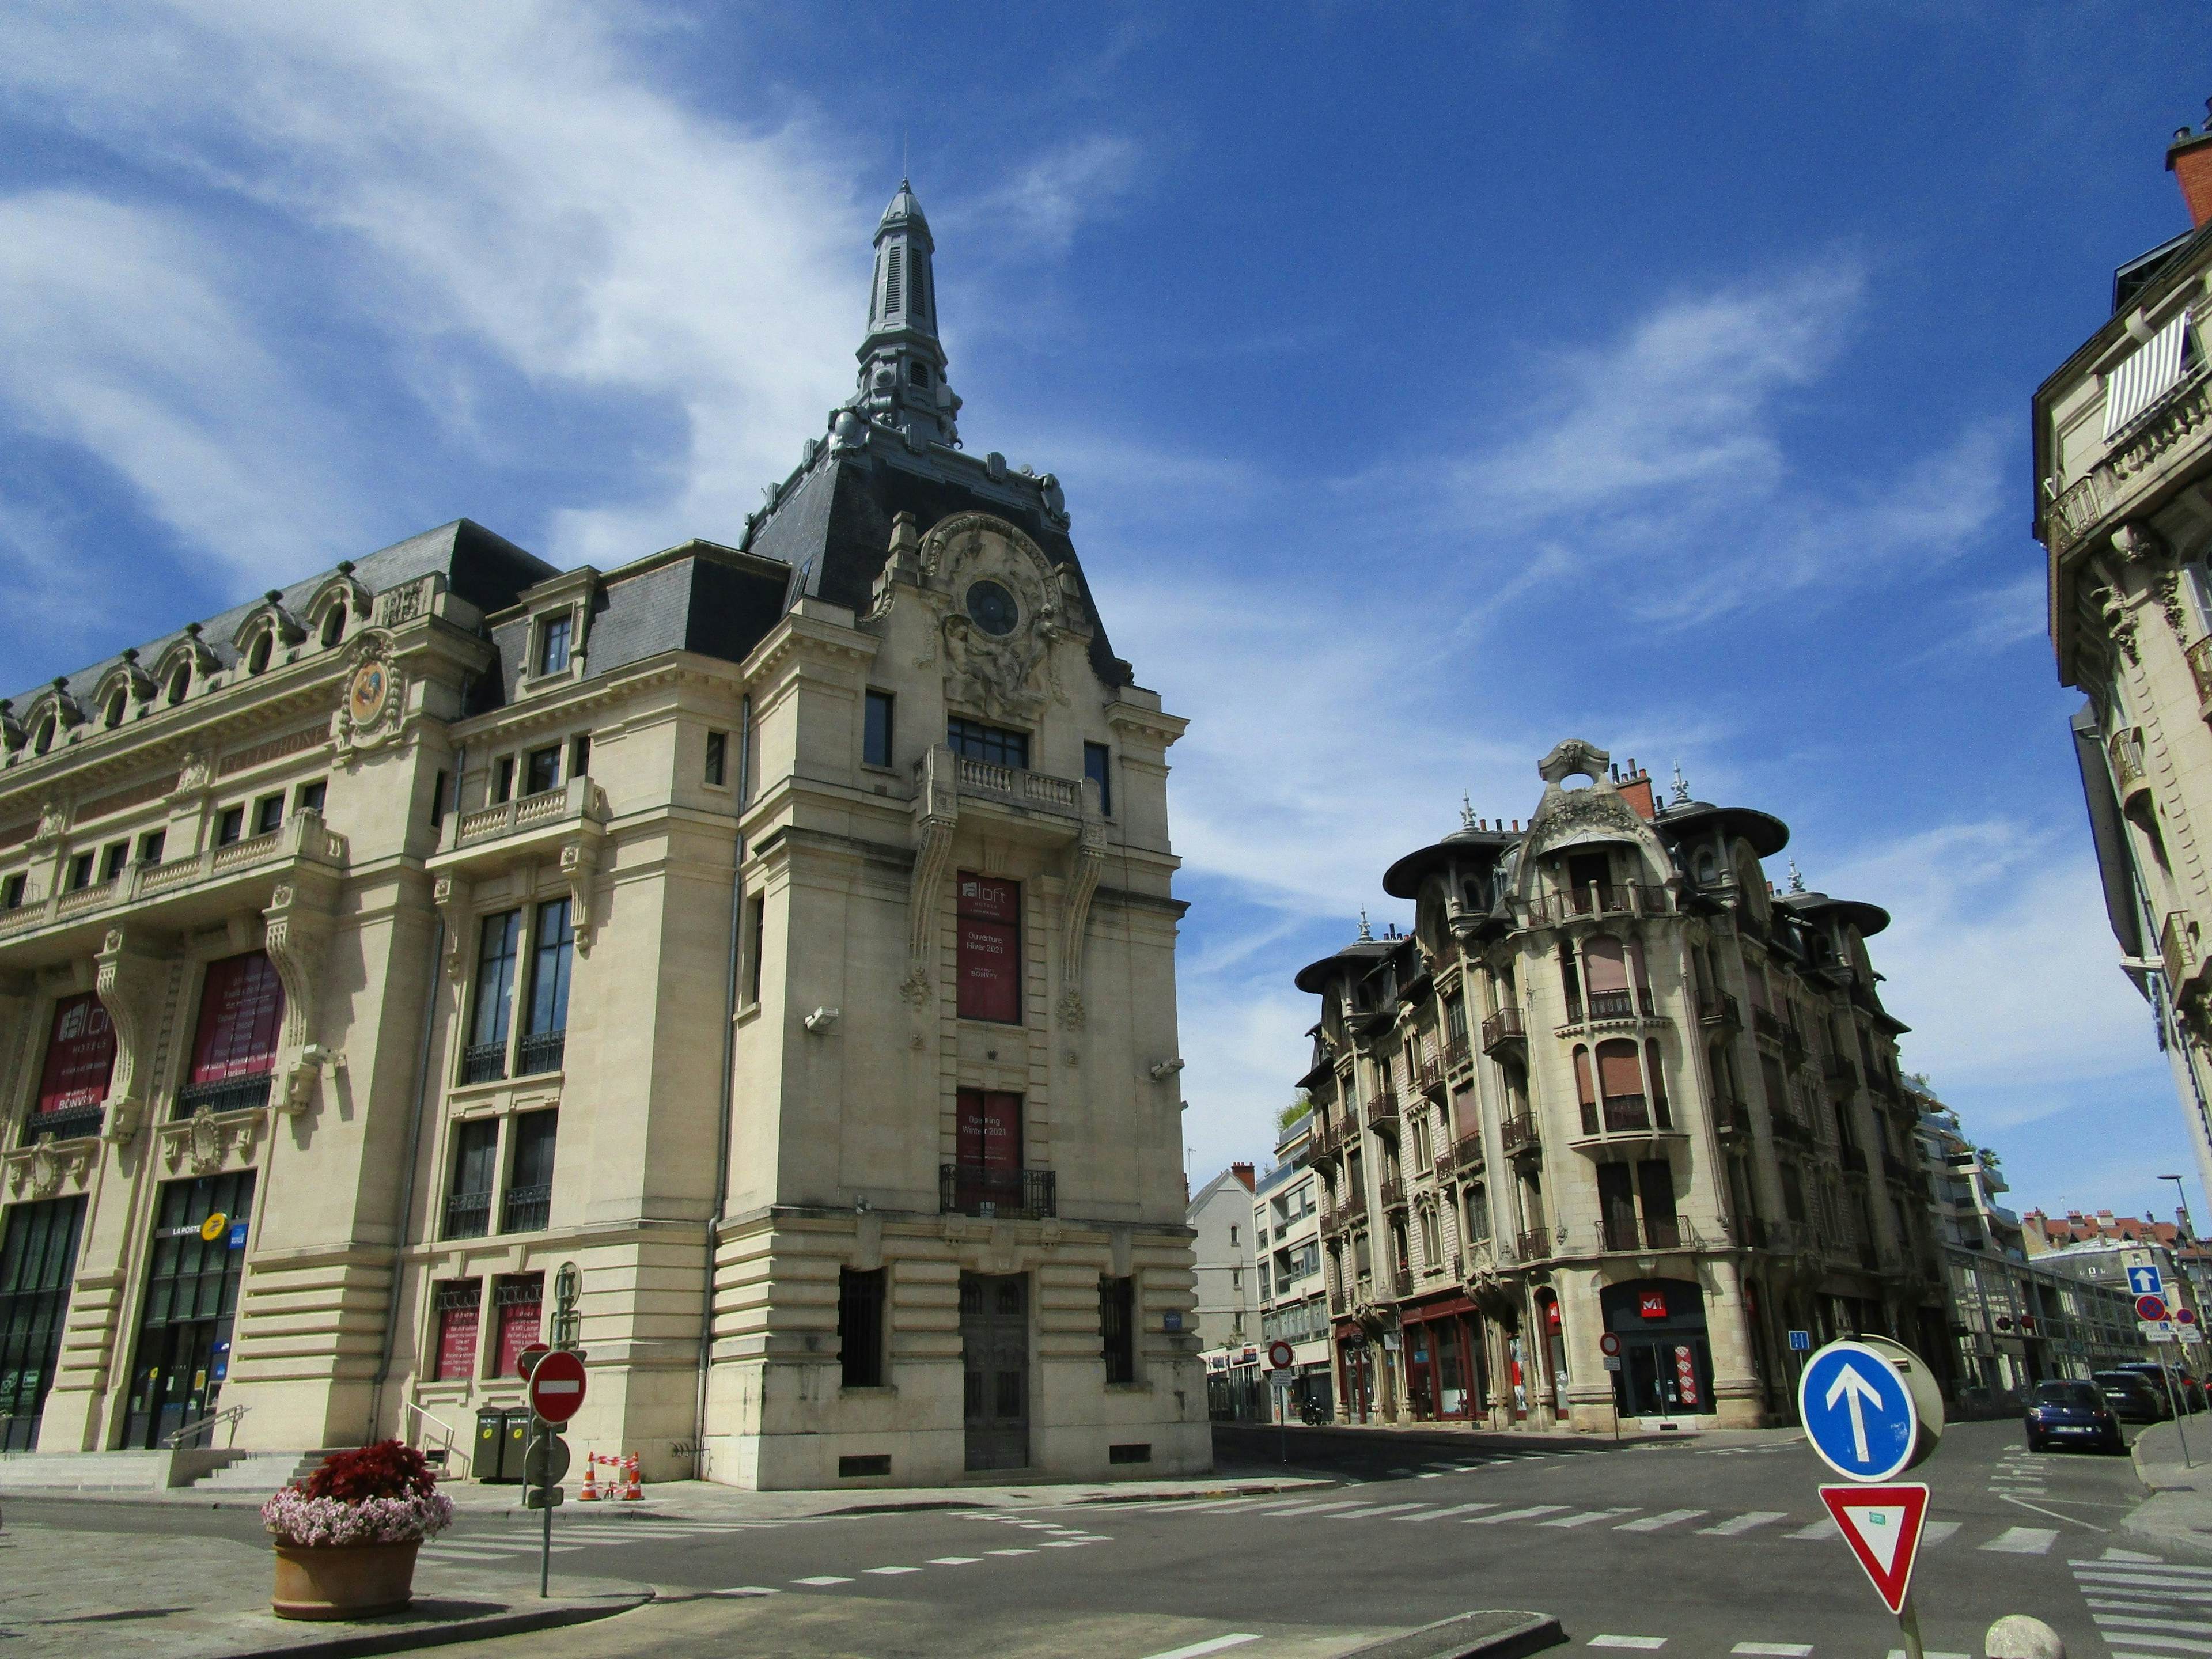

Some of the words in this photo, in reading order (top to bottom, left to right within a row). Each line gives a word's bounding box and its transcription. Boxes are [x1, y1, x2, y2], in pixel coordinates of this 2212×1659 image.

[963, 882, 1005, 904] aloft
[968, 931, 1002, 944] Ouverture
[967, 942, 986, 951] Hiver
[987, 945, 1003, 954] 2021
[969, 1115, 1000, 1127] Opening
[963, 1126, 987, 1135] Winter
[990, 1127, 1006, 1137] 2021
[173, 1228, 181, 1236] LA
[181, 1225, 201, 1234] POSTE
